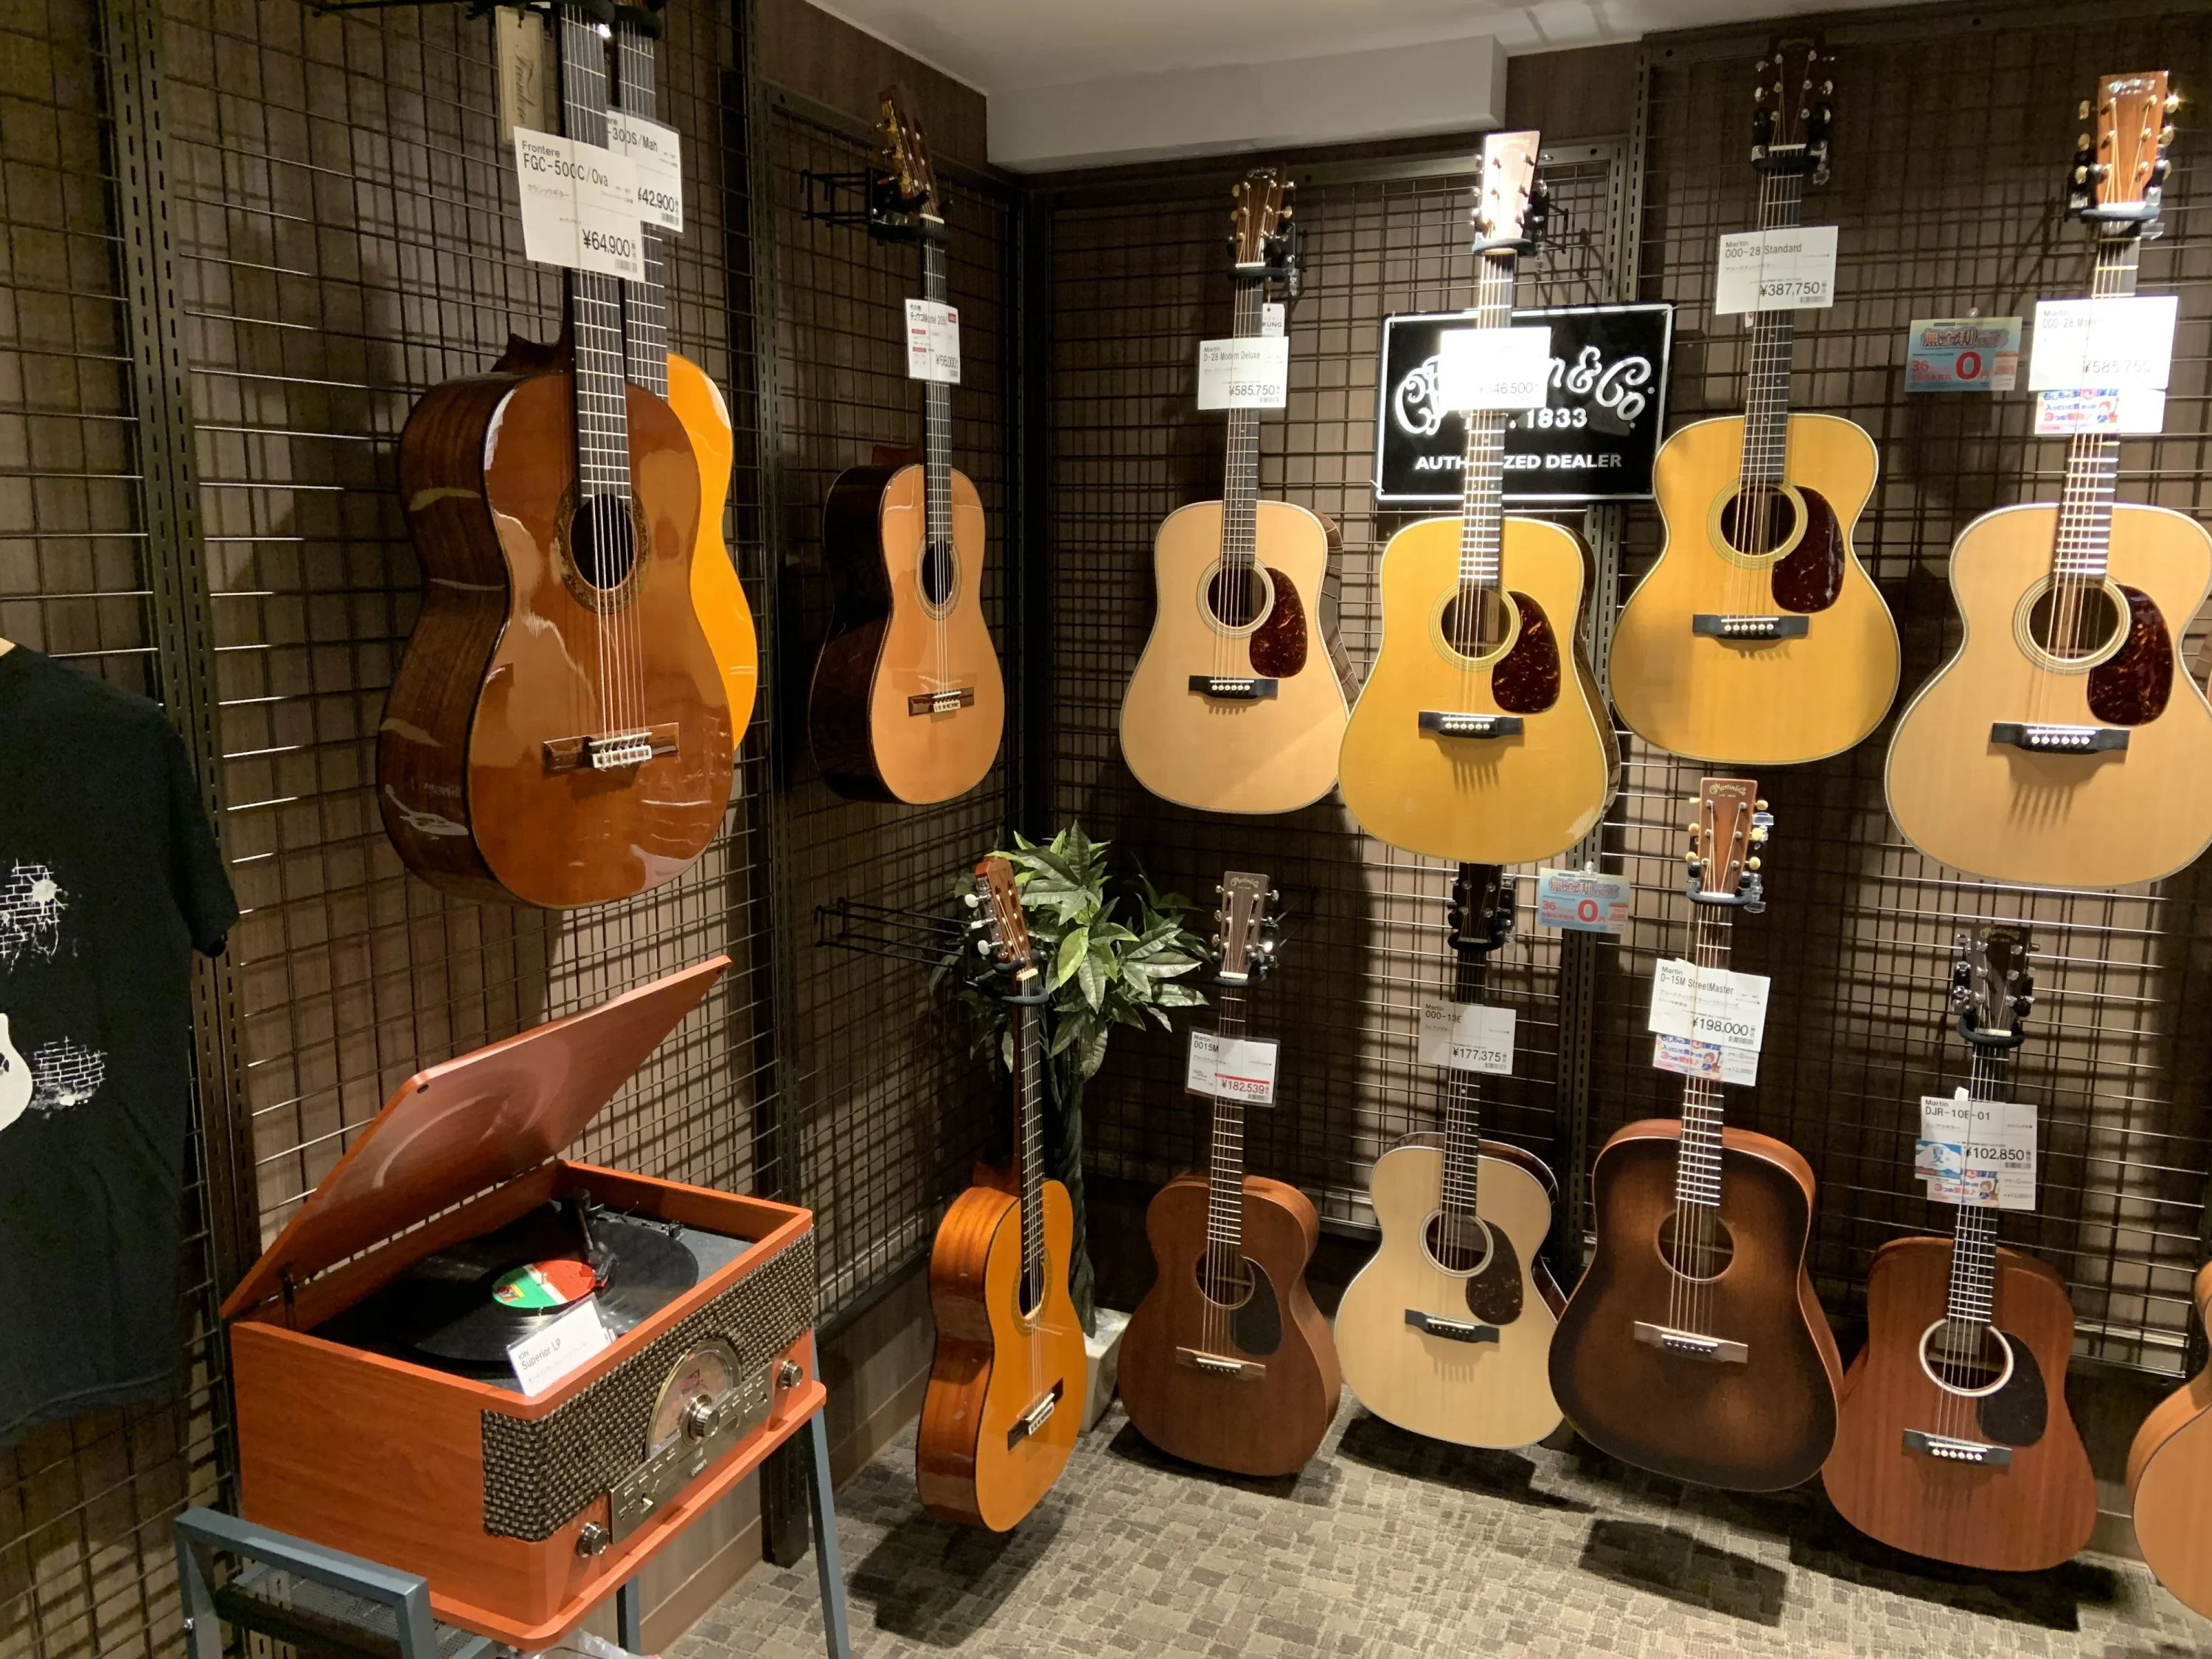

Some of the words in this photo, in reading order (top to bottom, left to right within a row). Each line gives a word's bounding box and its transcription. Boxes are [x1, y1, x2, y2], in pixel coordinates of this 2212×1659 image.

[608, 128, 658, 152] -300S/Mah
[521, 140, 560, 158] Frontere
[582, 229, 630, 257] ¥64,900
[1725, 247, 1761, 258] 000-28
[1764, 243, 1802, 255] Standard
[1759, 282, 1820, 296] ¥387,750
[1203, 352, 1219, 362] D-28
[1241, 350, 1261, 360] Deluxe
[2083, 359, 2152, 373] ¥585750
[1229, 385, 1275, 396] ¥585,750
[1526, 408, 1587, 429] 1833
[1415, 454, 1541, 470] AUTHZED
[1545, 453, 1622, 469] DEALER
[1661, 967, 1683, 975] Martin
[1660, 973, 1686, 986] D-15M
[1688, 978, 1734, 995] StreetMaster
[1426, 1004, 1444, 1012] Martin
[1425, 1010, 1462, 1023] 000-13E
[1691, 1017, 1748, 1036] ¥198,000
[1194, 1040, 1219, 1053] 0015M
[1453, 1047, 1501, 1062] ¥177,375
[1222, 1079, 1265, 1094] ¥182,539
[1925, 1106, 1990, 1121] DJR-10E-01
[1964, 1146, 2025, 1161] ¥102,850
[521, 1346, 551, 1371] Superior
[552, 1338, 562, 1352] LP
